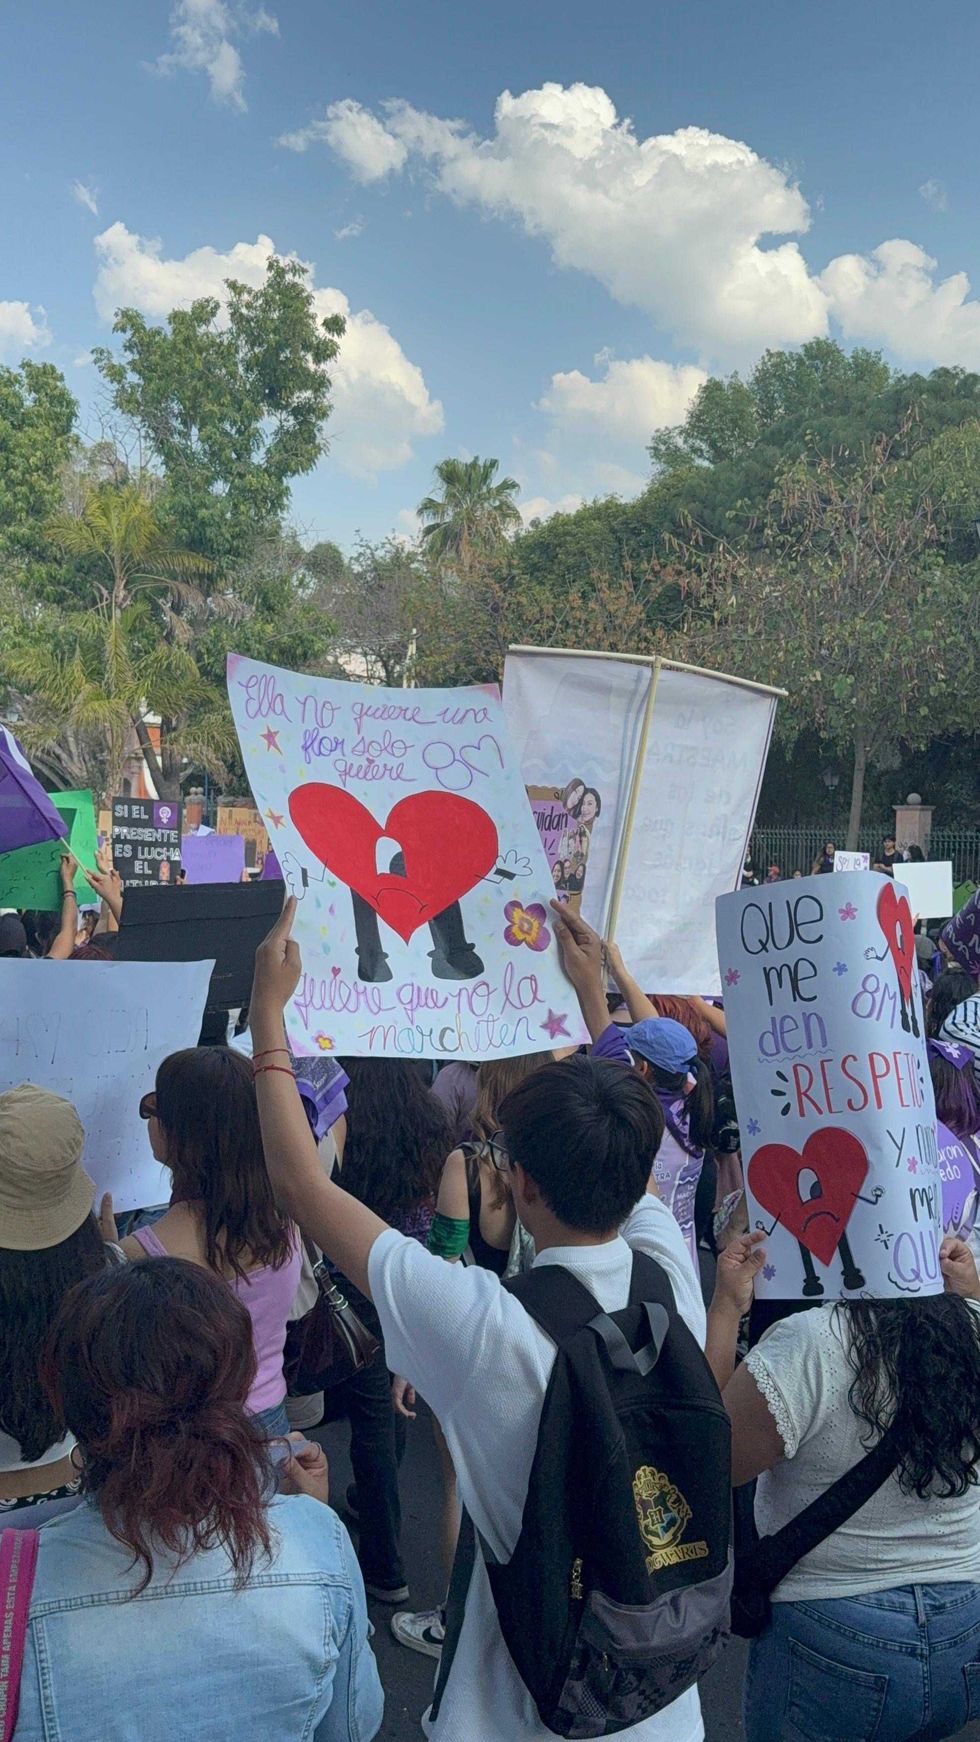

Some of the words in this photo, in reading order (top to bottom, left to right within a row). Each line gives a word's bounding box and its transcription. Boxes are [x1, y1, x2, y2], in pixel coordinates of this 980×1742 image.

[238, 674, 292, 723] Ella
[301, 728, 345, 764] flor
[352, 729, 414, 758] solo
[114, 804, 129, 818] SI
[131, 804, 149, 819] EL
[112, 825, 179, 843] PRESENTE
[114, 844, 133, 858] ES
[137, 846, 182, 861] LUCHA
[134, 860, 152, 875] EL
[396, 981, 449, 1025] que
[448, 980, 498, 1016] no
[500, 961, 545, 1015] la
[762, 957, 818, 1006] me
[359, 1012, 536, 1054] marchiten
[758, 1010, 828, 1057] den
